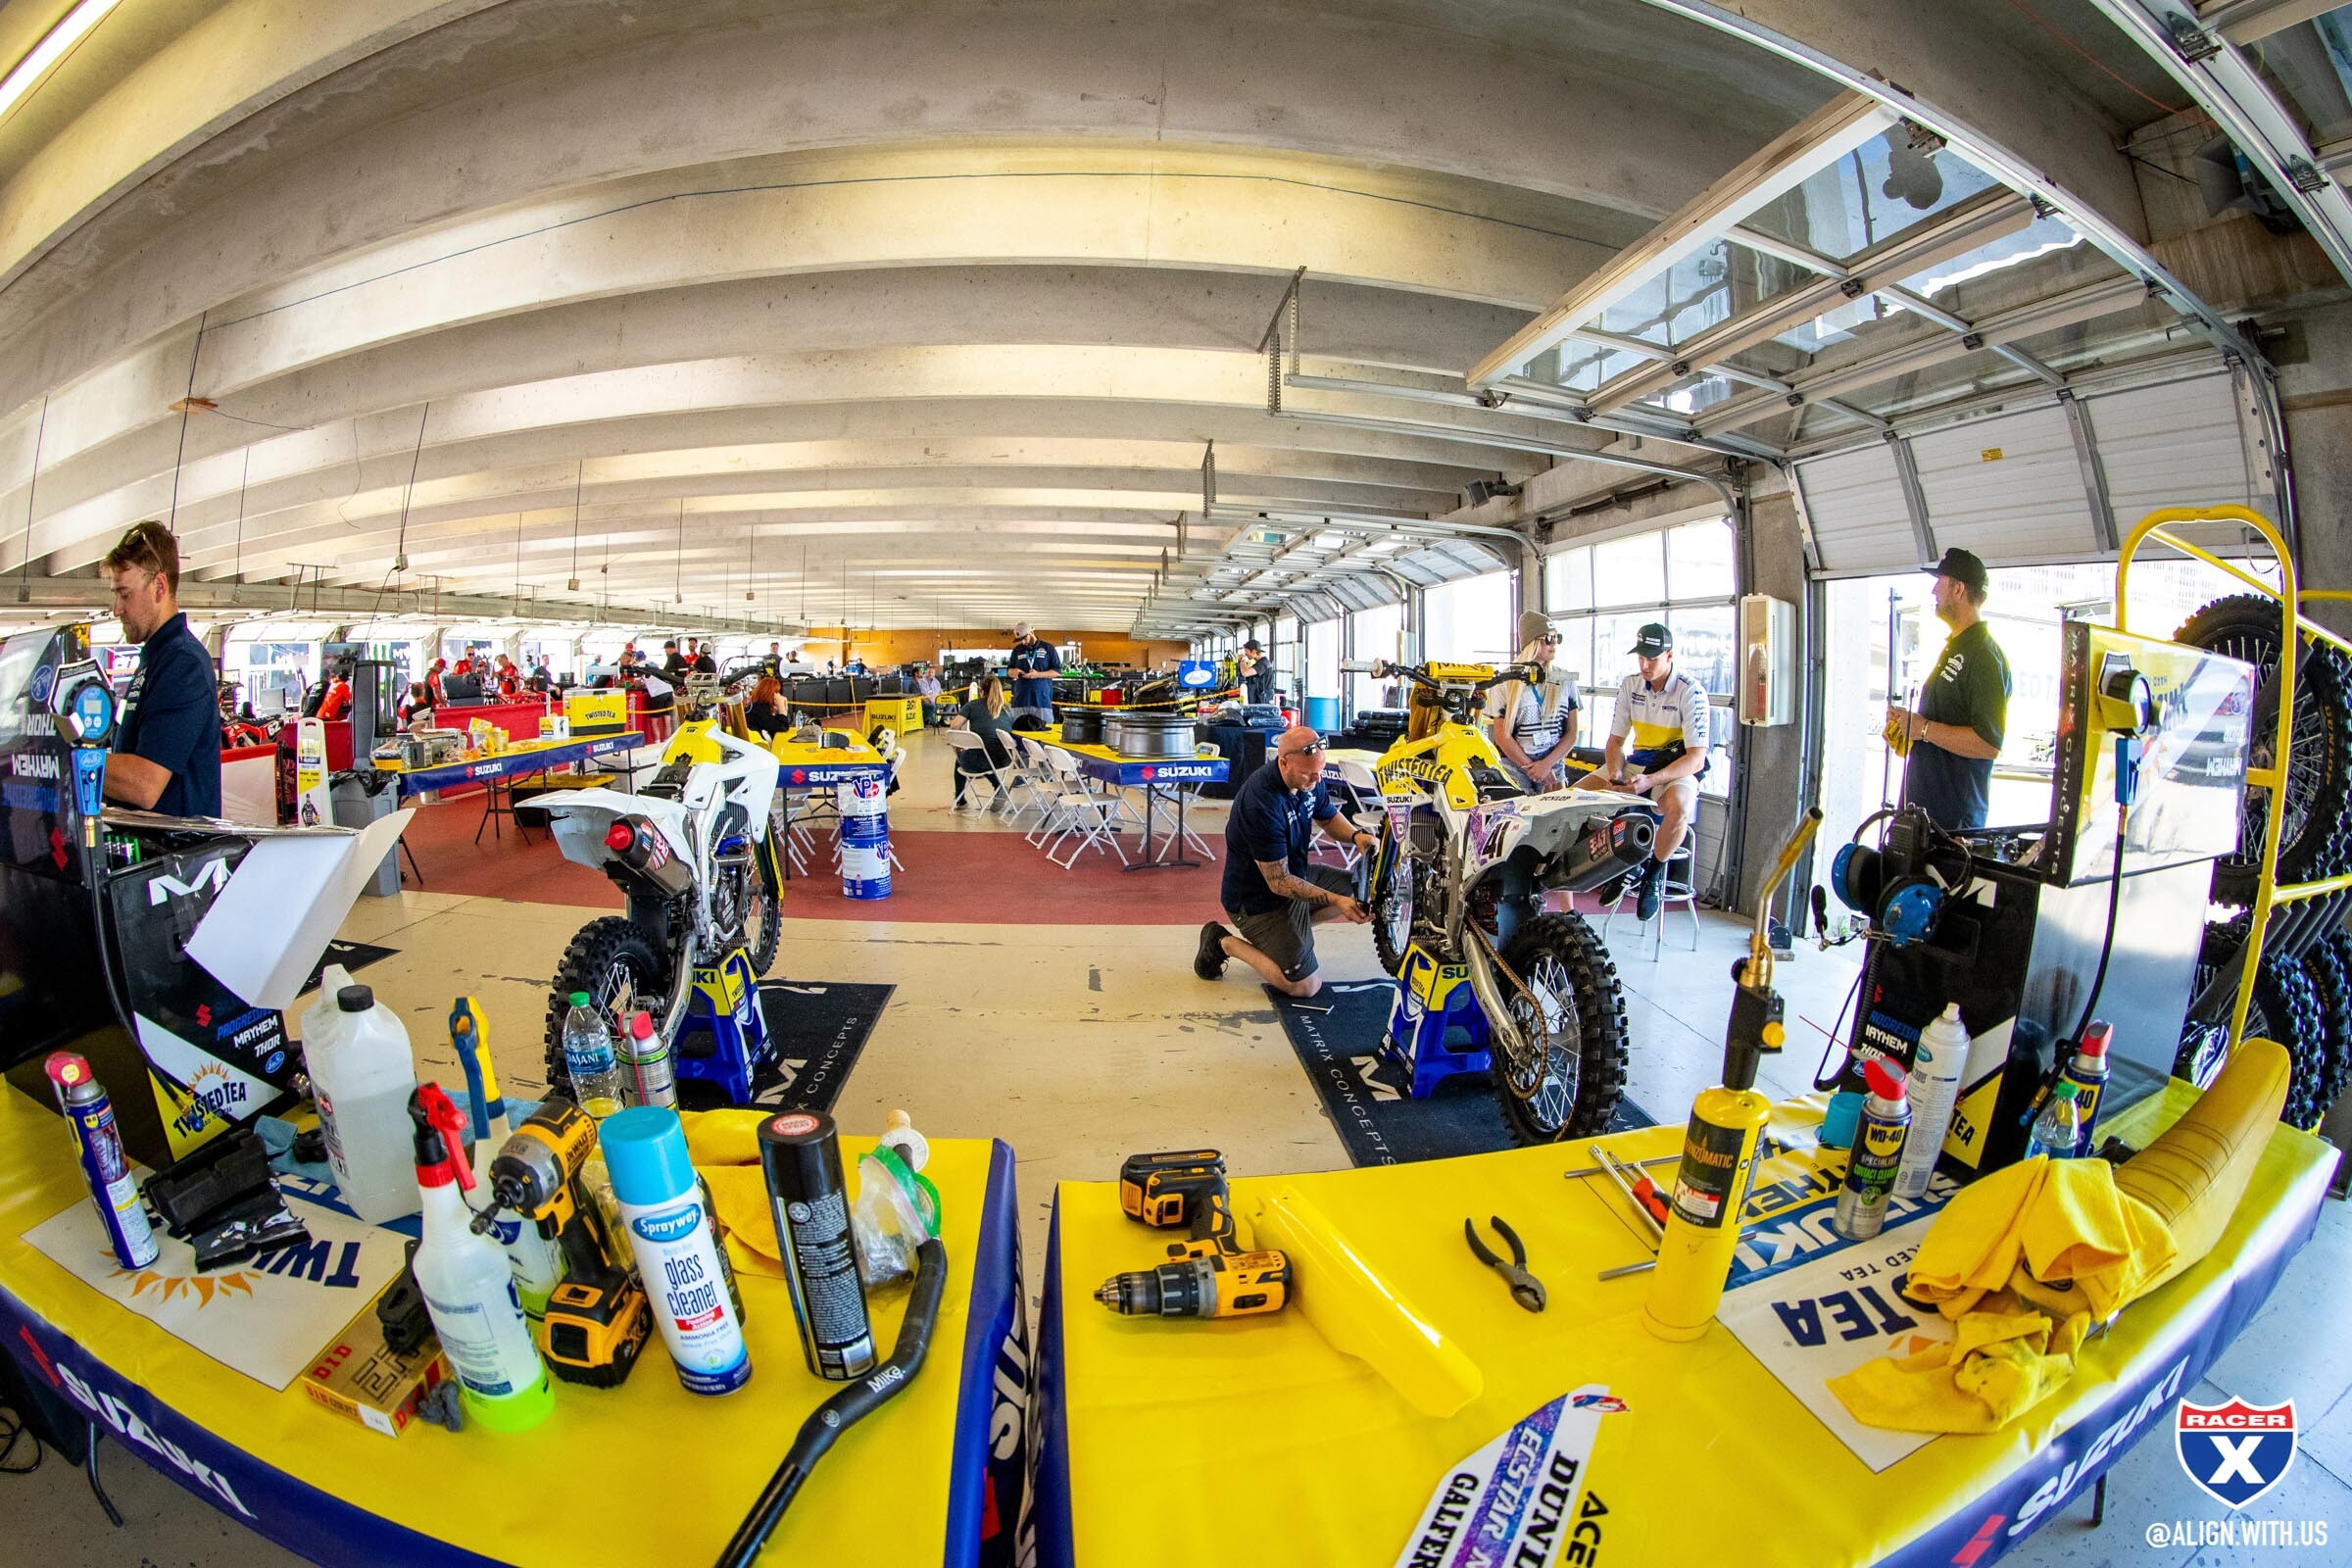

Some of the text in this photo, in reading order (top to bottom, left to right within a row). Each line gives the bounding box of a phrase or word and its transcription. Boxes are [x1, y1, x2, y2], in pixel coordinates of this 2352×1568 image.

[593, 742, 613, 754] SUZUKI
[12, 754, 60, 779] MAYHEM
[474, 762, 503, 776] SUZUKI
[1157, 765, 1212, 779] SUZUKI
[1321, 769, 1344, 781] SUZU
[1482, 819, 1510, 859] 41
[233, 1014, 279, 1049] MAYHEM
[254, 1034, 281, 1058] THOR
[564, 1052, 600, 1066] DASANI
[806, 1017, 858, 1095] CONCEPTS
[222, 1082, 247, 1103] TEA
[1299, 1013, 1397, 1166] MATRIX CONCEPTS
[1870, 1126, 1903, 1144] WD-40
[1949, 1109, 1977, 1147] TEA
[640, 1208, 700, 1238] Sprayway
[664, 1253, 705, 1291] glass
[1838, 1262, 1882, 1282] TEA
[667, 1280, 718, 1317] cleaner
[1771, 1286, 1919, 1348] TEA
[680, 1330, 715, 1342] AMMONIA
[56, 1361, 258, 1520] SUZUKI
[2007, 1353, 2191, 1538] SUZUKI
[1483, 1426, 1544, 1542] ECSTAR
[1512, 1450, 1581, 1568] DUNL
